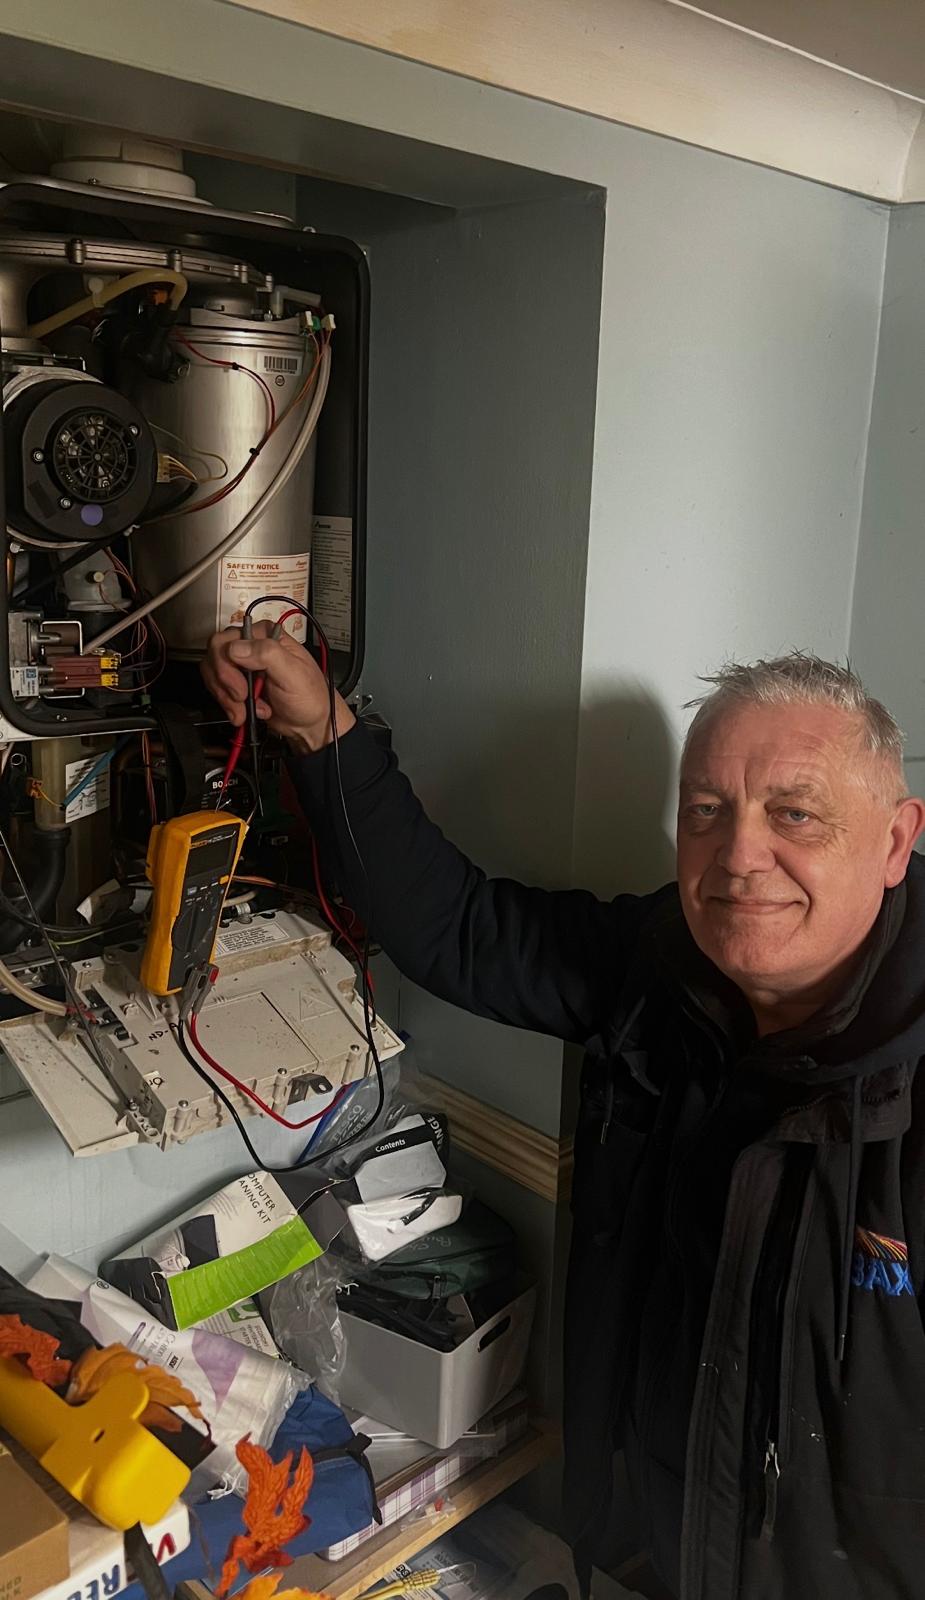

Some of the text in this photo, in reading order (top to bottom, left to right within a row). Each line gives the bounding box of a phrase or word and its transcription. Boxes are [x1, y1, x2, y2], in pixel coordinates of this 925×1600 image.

[226, 562, 254, 570] SAFETY
[212, 779, 239, 789] BOCH
[375, 1138, 406, 1152] Contents
[257, 1209, 271, 1224] KIT
